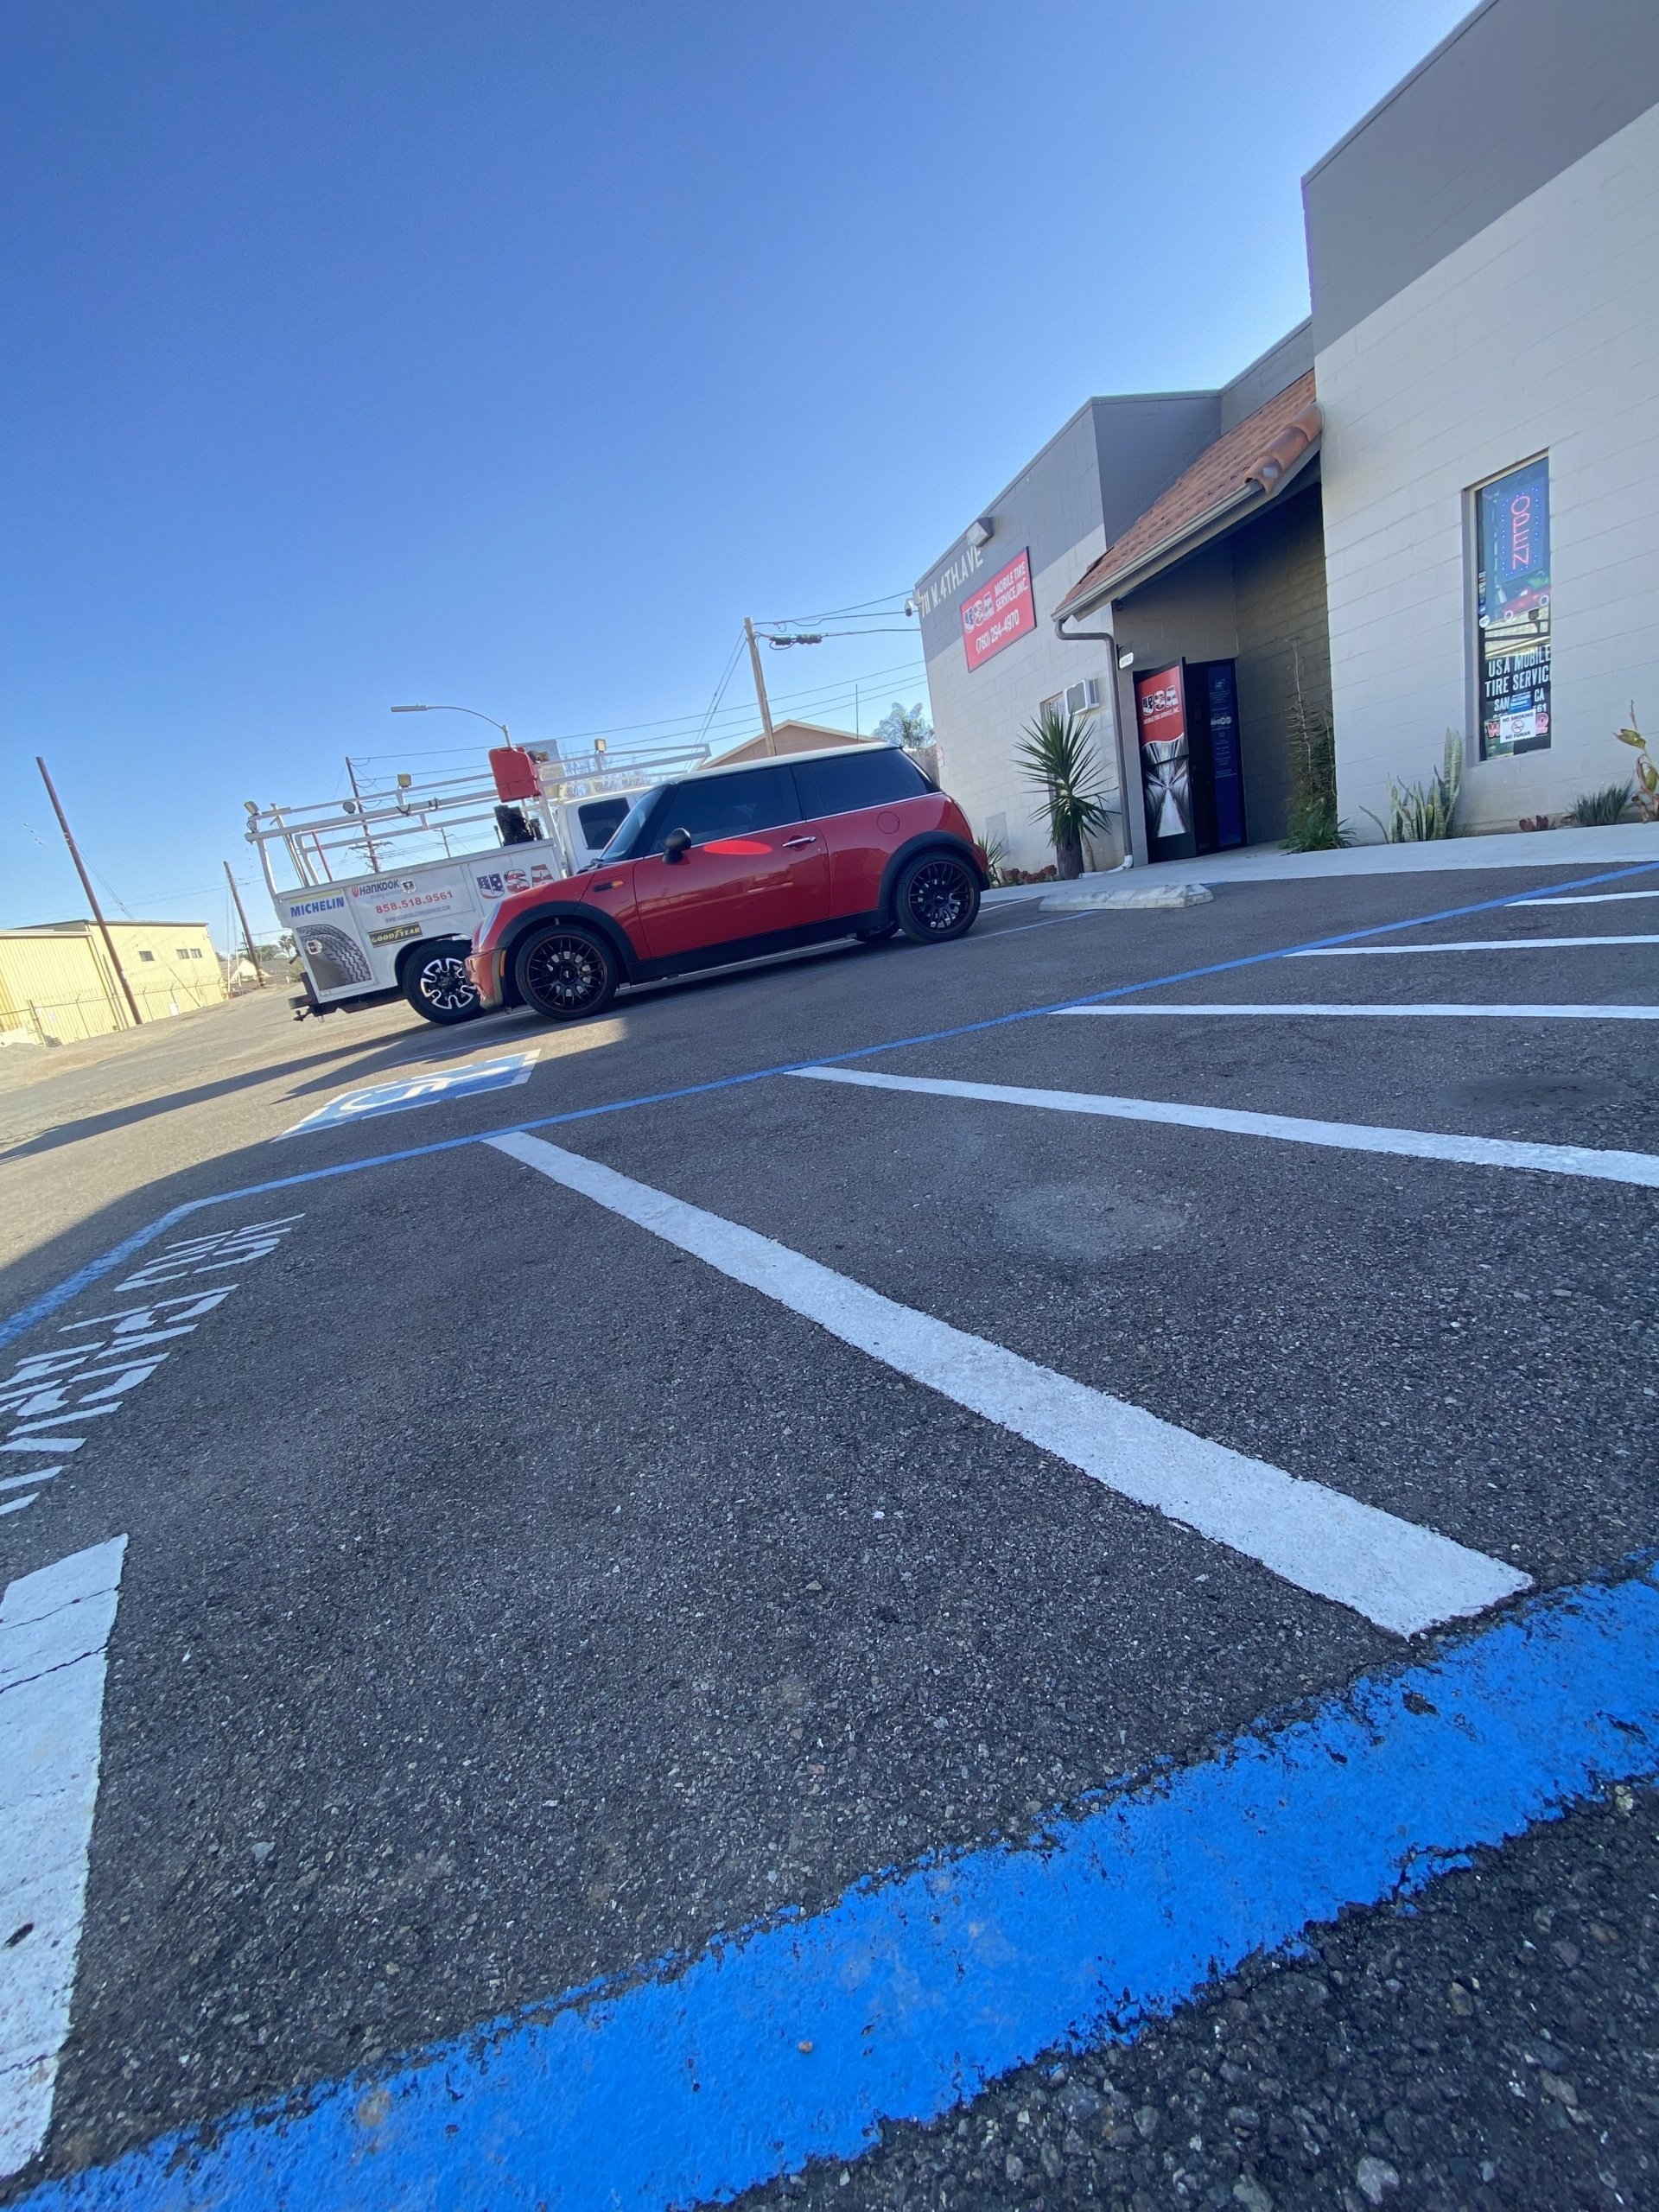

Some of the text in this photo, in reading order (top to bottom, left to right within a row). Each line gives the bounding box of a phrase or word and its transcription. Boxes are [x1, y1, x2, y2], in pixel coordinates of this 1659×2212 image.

[1510, 495, 1531, 570] OPEN
[995, 561, 1027, 597] MOBILE TIRE
[963, 591, 995, 633] USA
[976, 608, 1020, 655] (760) 294-4970
[1488, 644, 1551, 677] USA MOBILE
[1484, 664, 1551, 697] TIRE SERVIC
[1141, 684, 1179, 716] USA
[1494, 696, 1510, 711] SAN
[1534, 688, 1545, 702] CA
[1510, 712, 1534, 721] SMOKING
[476, 863, 554, 899] USA
[290, 897, 345, 918] MICHELIN
[375, 890, 453, 914] 858.518.9561
